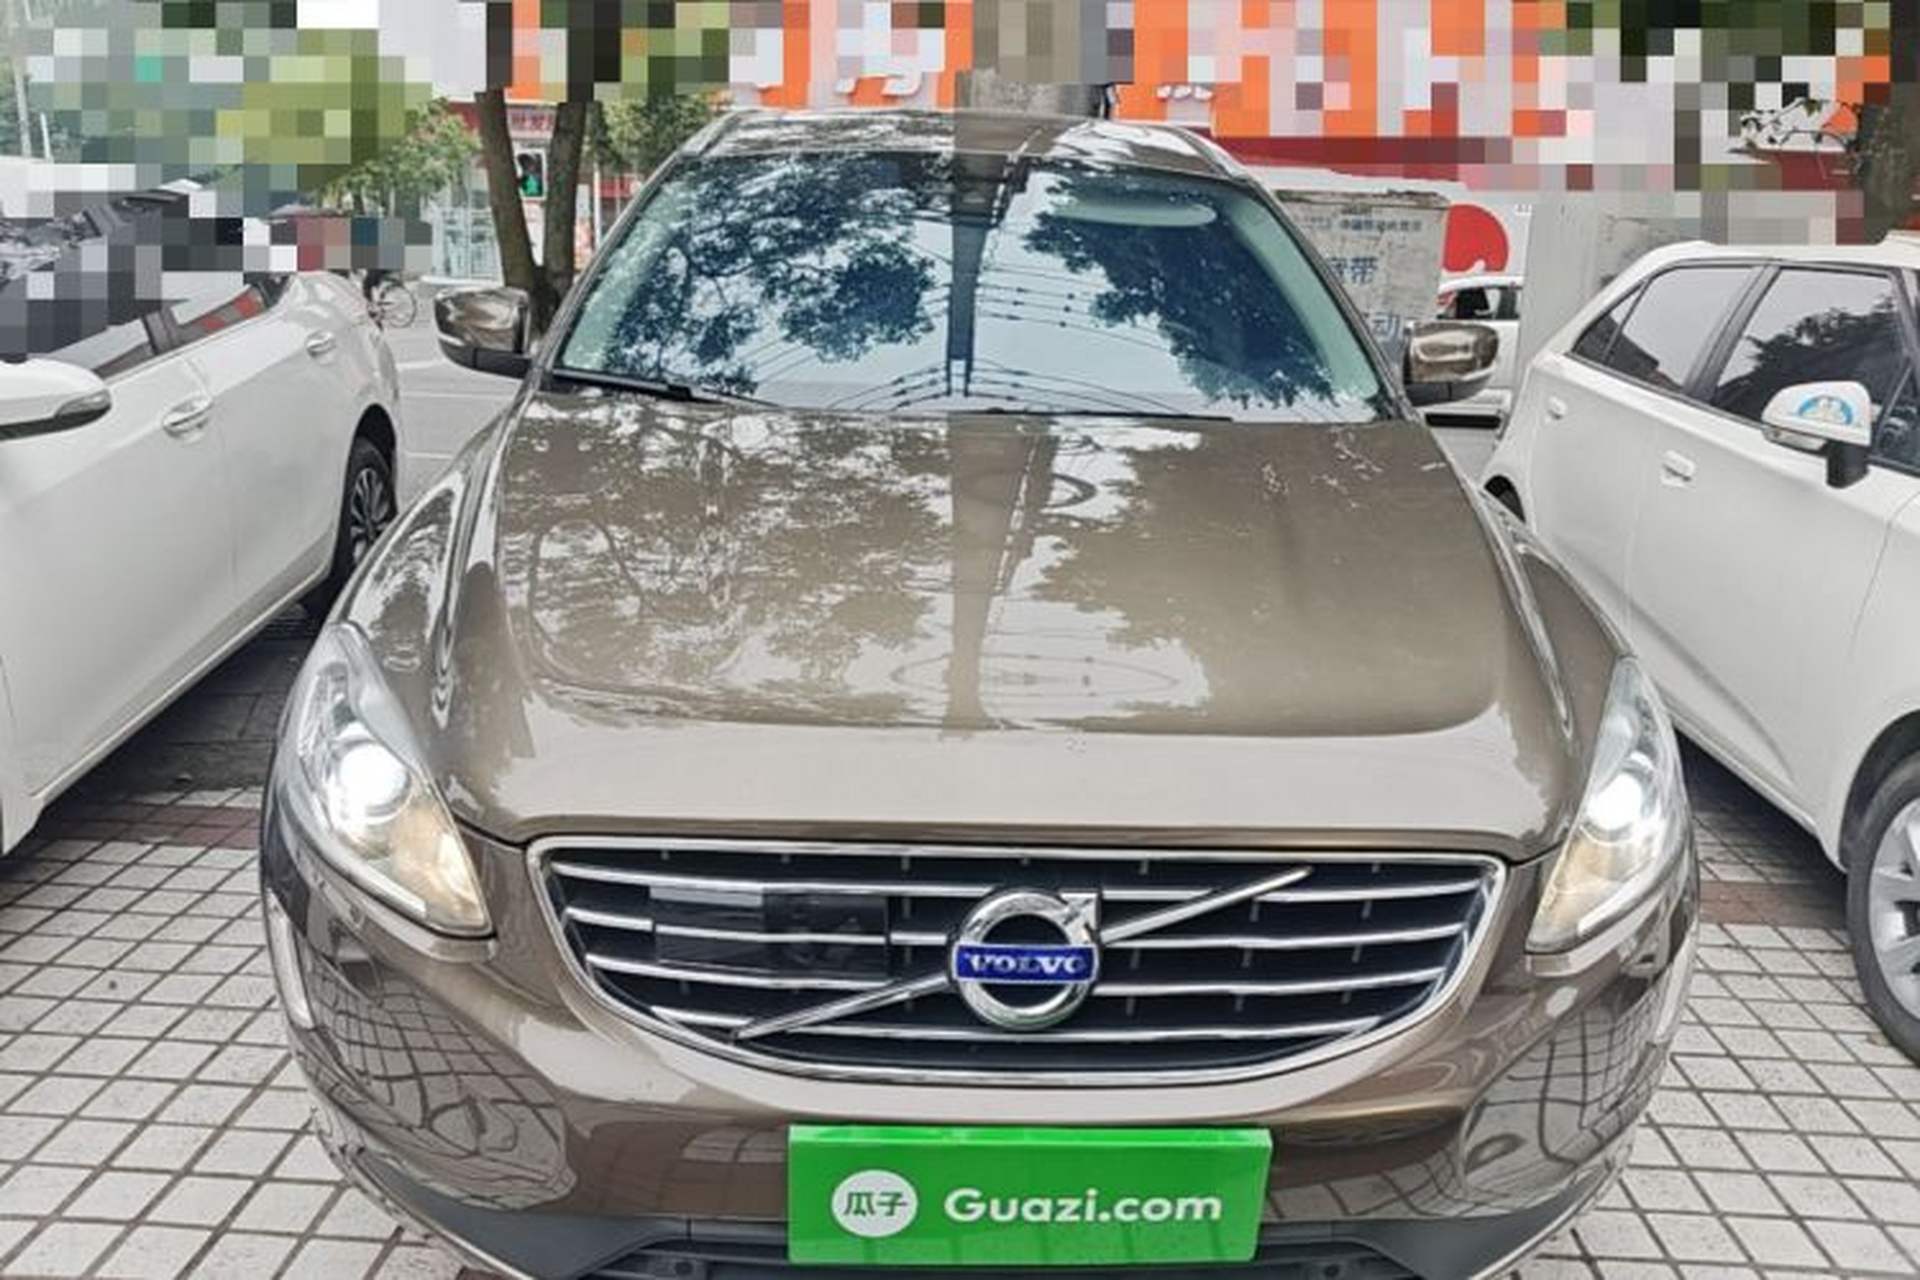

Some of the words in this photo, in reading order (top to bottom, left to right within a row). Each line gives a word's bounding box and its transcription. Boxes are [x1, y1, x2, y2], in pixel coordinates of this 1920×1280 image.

[964, 952, 1087, 975] VOLVO
[843, 1191, 908, 1217] 瓜子
[944, 1187, 1222, 1223] Guazi.com
